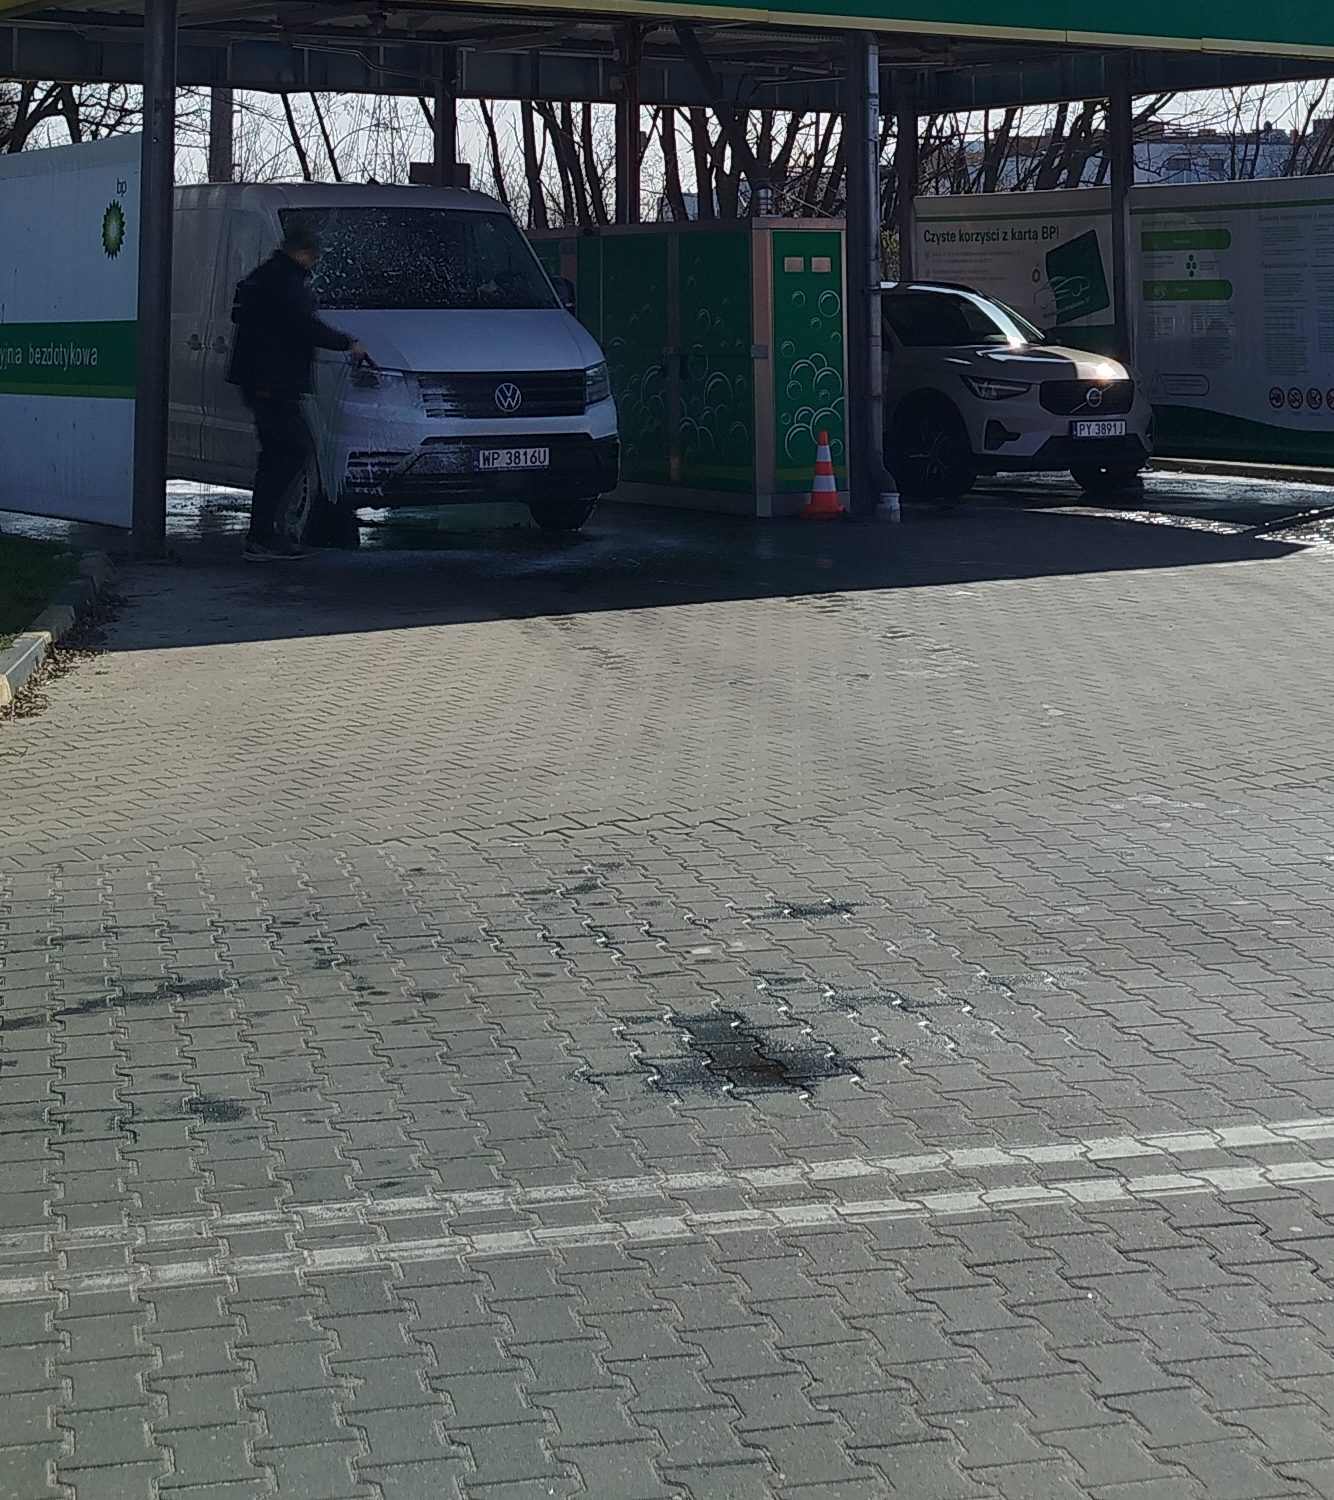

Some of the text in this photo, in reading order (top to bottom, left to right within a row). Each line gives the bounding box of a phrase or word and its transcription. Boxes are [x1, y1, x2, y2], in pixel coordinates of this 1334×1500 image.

[924, 229, 956, 245] Czyste
[959, 228, 999, 245] korzyści
[1003, 231, 1008, 241] z
[1011, 227, 1038, 243] kartą
[29, 342, 98, 371] bezdotykowa
[1079, 422, 1123, 436] PY 3891J
[482, 451, 500, 467] WP
[505, 449, 547, 466] 3816U
